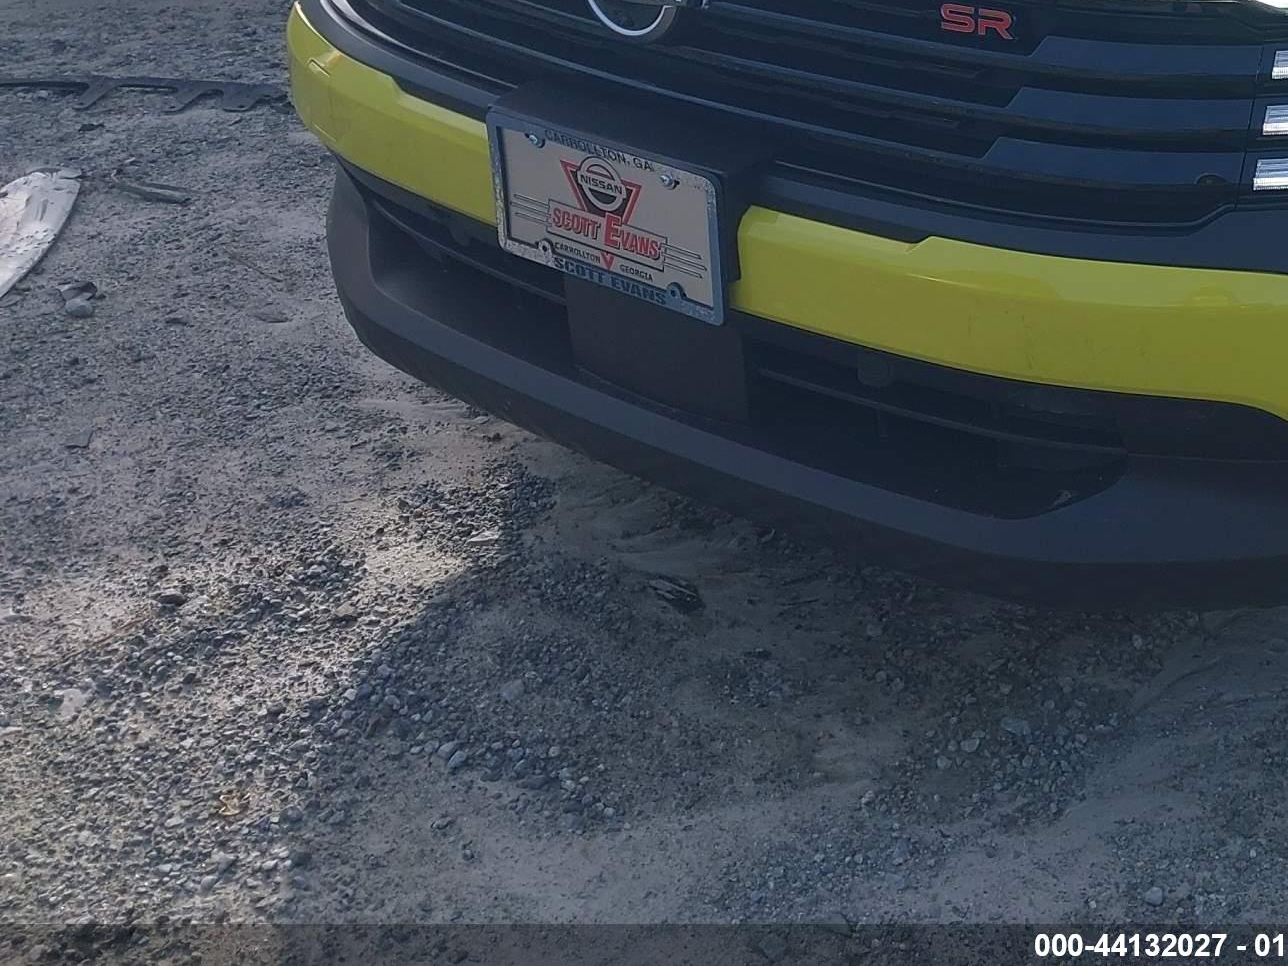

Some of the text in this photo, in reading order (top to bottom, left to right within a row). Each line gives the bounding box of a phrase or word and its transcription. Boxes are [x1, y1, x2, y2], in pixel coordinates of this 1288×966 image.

[940, 3, 1014, 40] SR
[544, 129, 630, 166] CARROLLTON,
[580, 174, 623, 195] NISSAN
[552, 208, 662, 261] SCOTT EVANS
[554, 242, 601, 264] CARROLLTON
[554, 257, 667, 305] SCOTT EVANS
[620, 264, 653, 282] GEORGIA
